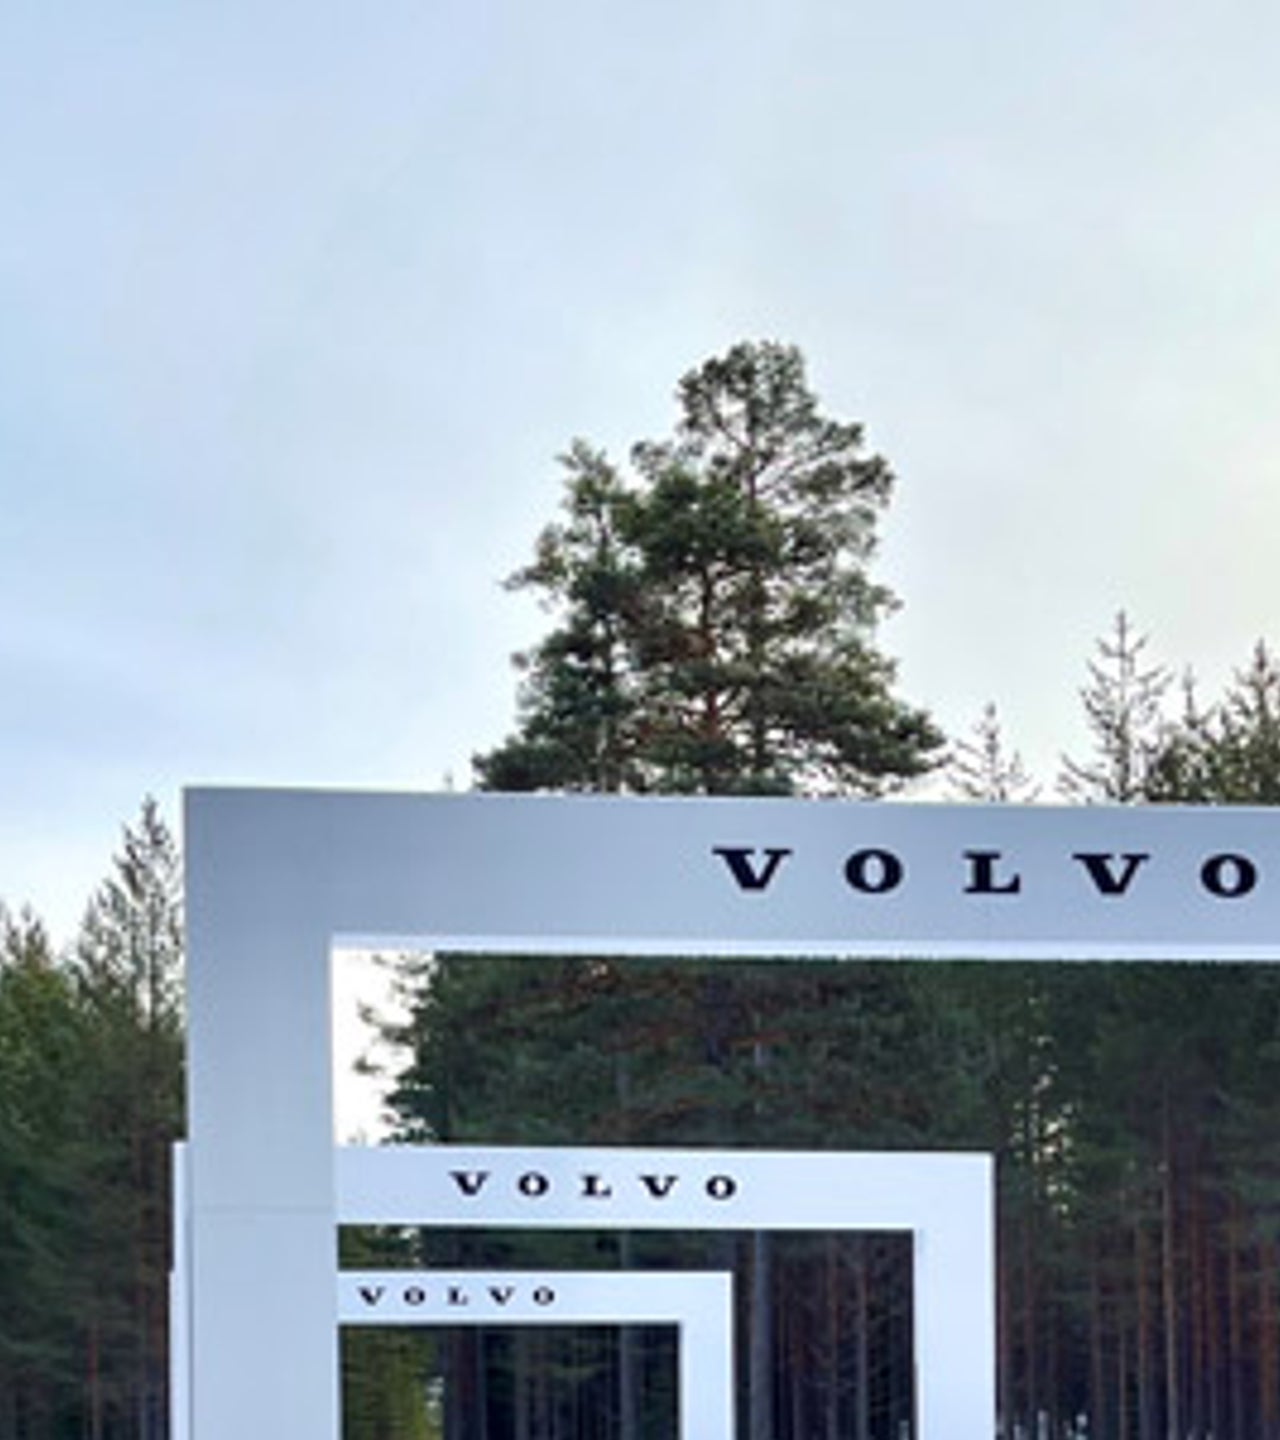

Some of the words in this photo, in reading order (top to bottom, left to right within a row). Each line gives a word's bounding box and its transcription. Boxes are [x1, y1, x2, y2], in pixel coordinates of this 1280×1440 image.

[712, 848, 1258, 898] VOLVO
[451, 1171, 738, 1201] VOLVO
[359, 1286, 556, 1306] VOLVO
